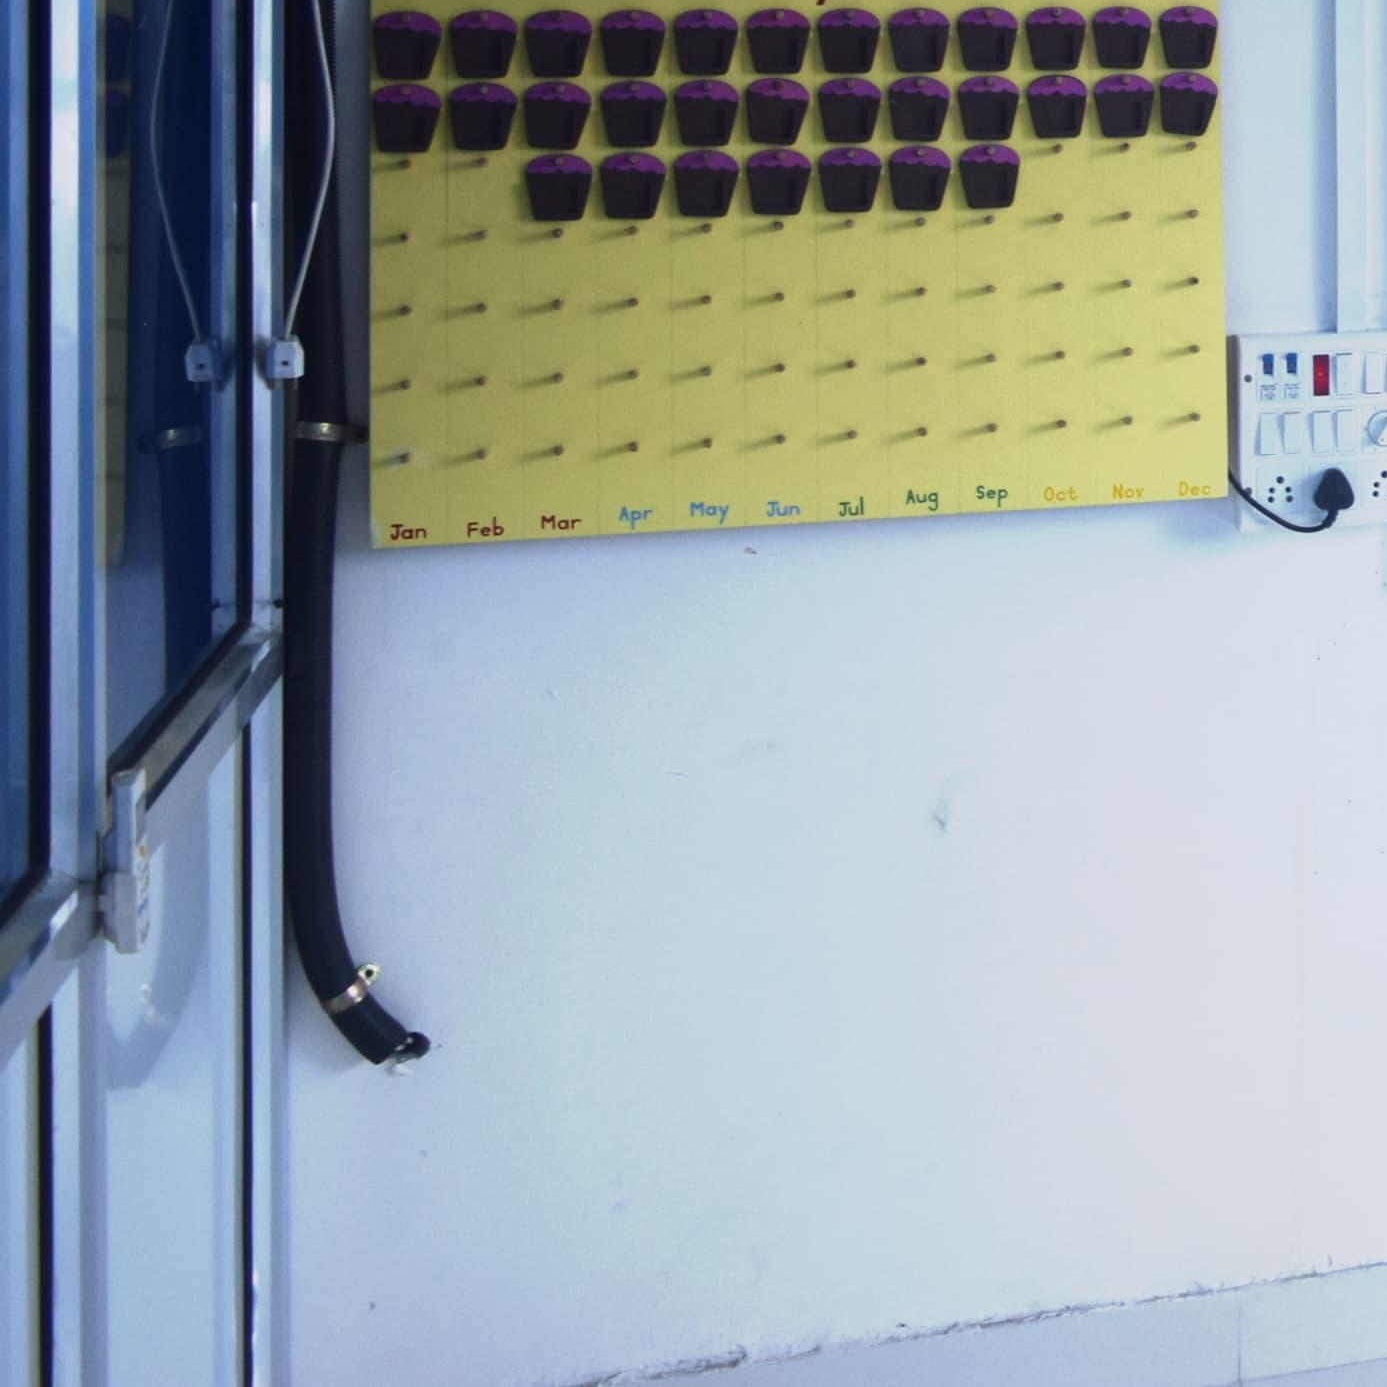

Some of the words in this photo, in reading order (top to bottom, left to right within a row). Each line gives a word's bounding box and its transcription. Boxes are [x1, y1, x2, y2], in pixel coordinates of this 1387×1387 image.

[390, 523, 427, 540] Jan
[467, 517, 504, 537] Feb
[541, 515, 582, 530] Mar
[619, 506, 653, 529] Apr
[689, 501, 730, 525] May
[766, 501, 801, 517] Jun
[838, 496, 865, 516] Jul
[906, 489, 939, 511] Aug
[976, 485, 1009, 508] Sep
[1043, 486, 1078, 501] Oct
[1112, 484, 1145, 499] Nov
[1178, 481, 1212, 497] Dec
